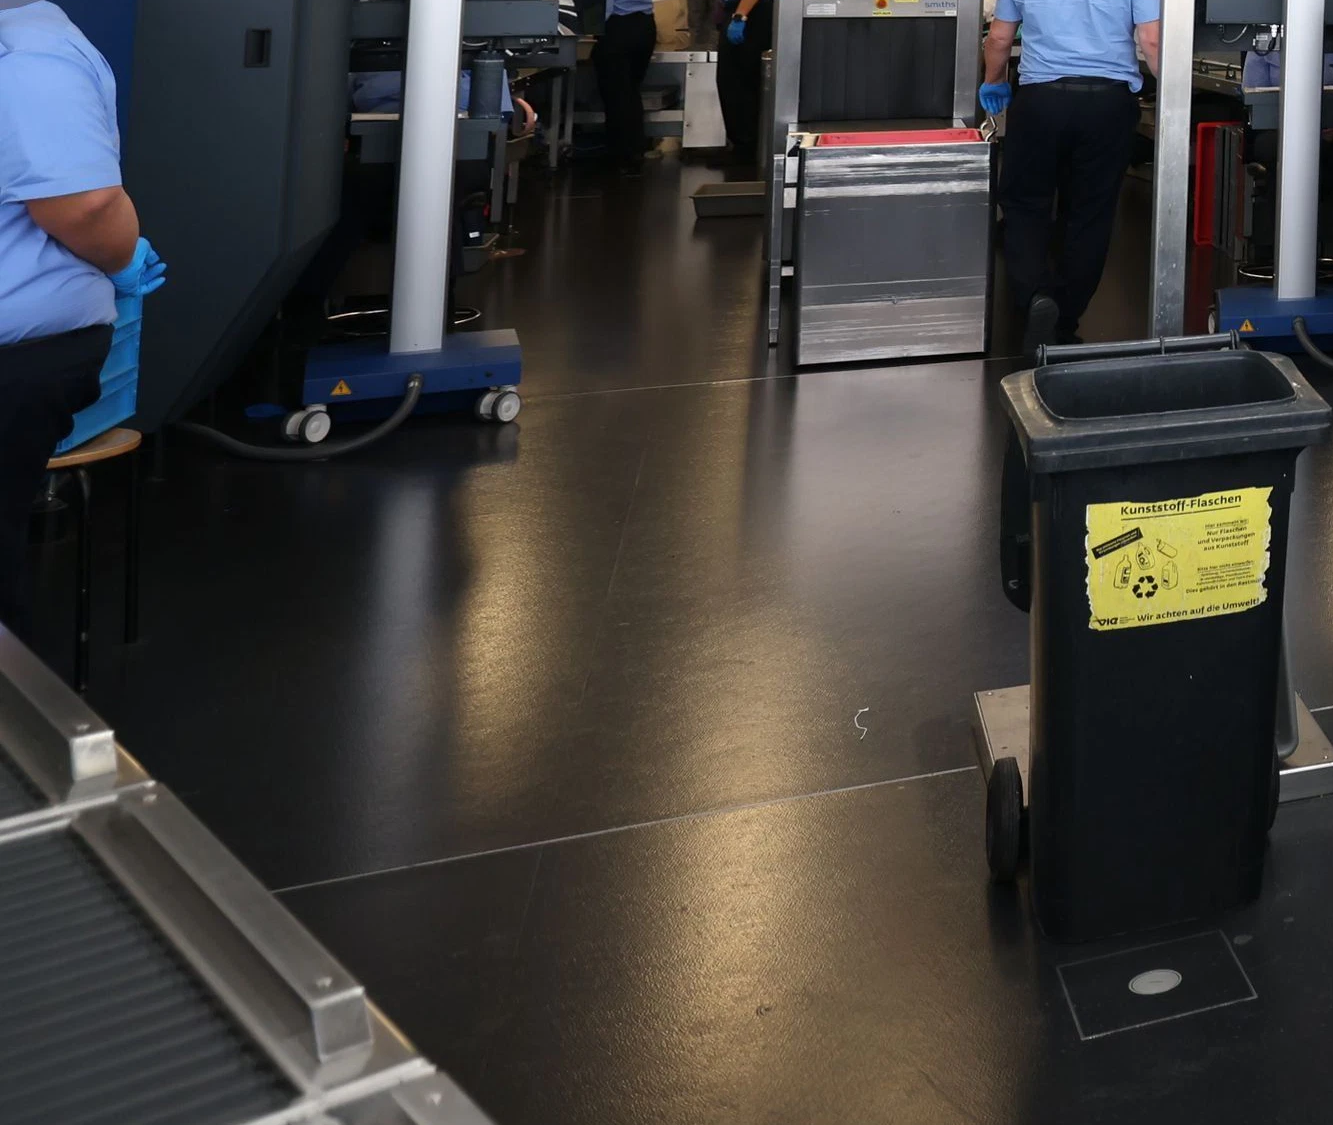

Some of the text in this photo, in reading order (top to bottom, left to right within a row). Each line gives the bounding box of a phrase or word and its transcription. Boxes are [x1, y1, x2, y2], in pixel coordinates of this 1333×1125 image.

[924, 1, 956, 9] smiths
[1121, 493, 1242, 516] Kunststoff-Flaschen
[1216, 540, 1250, 550] Kunststoff
[1137, 614, 1154, 622] Wir
[1156, 610, 1188, 621] achten
[1190, 606, 1205, 616] auf
[1207, 604, 1220, 613] die
[1222, 597, 1260, 611] Umwelt!
